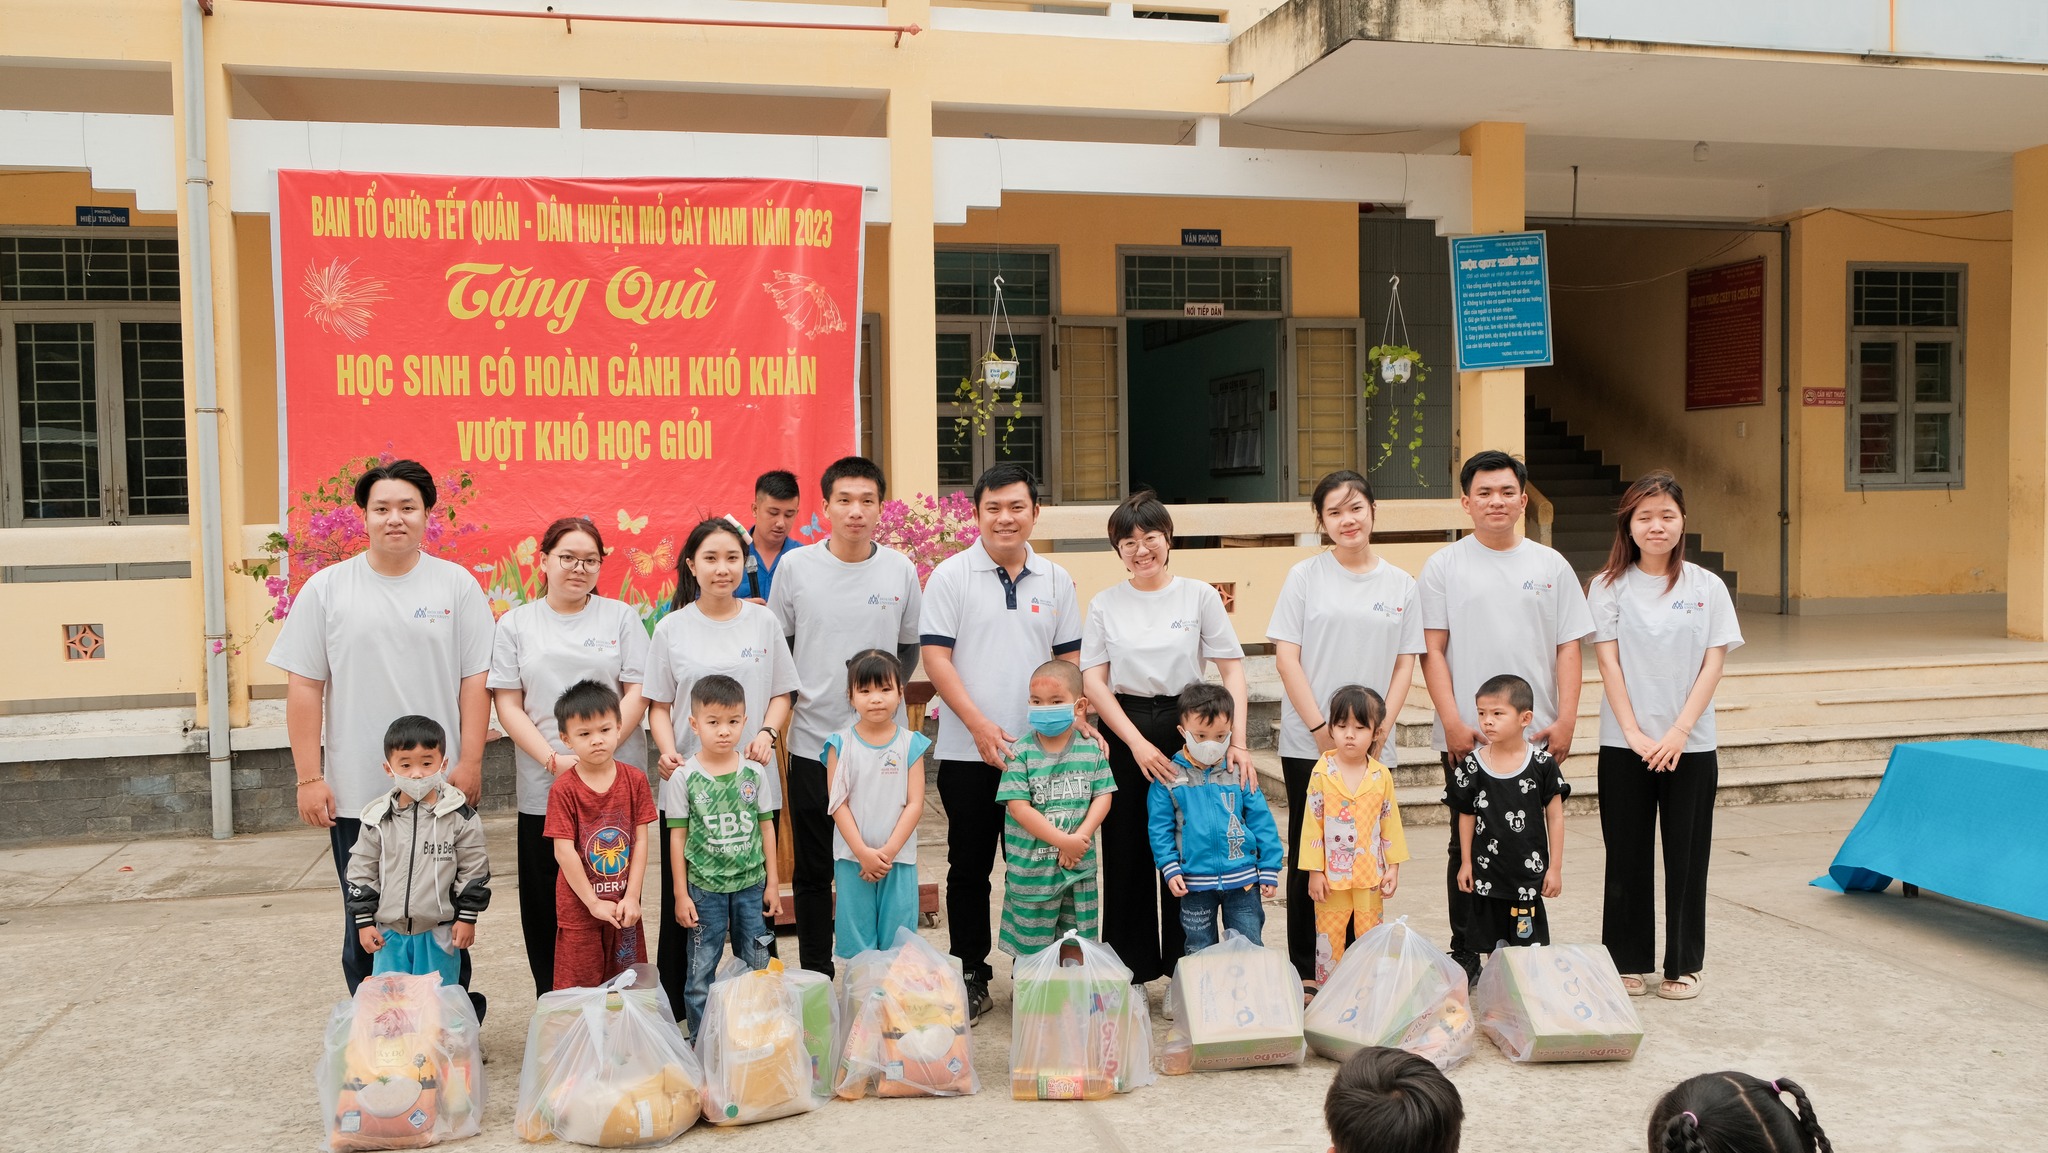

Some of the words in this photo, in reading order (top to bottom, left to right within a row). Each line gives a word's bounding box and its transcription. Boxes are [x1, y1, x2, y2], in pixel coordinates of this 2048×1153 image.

[80, 215, 97, 224] HIỆU
[98, 214, 126, 223] TRƯỞNG
[311, 195, 350, 237] BAN
[355, 181, 377, 238] TỔ
[383, 190, 430, 239] CHỨC
[435, 187, 466, 239] TẾT
[471, 192, 519, 245] QUÂN
[537, 194, 573, 242] DÂN
[578, 196, 634, 253] HUYỆN
[639, 192, 666, 245] MỎ
[671, 198, 703, 245] CÀY
[708, 206, 747, 245] NAM
[752, 199, 790, 246] NĂM
[795, 208, 833, 248] 2023
[1184, 232, 1197, 243] VĂN
[1198, 232, 1218, 243] PHÒNG
[445, 262, 590, 334] Tặng
[605, 265, 717, 325] Quà
[1186, 306, 1195, 315] NƠI
[1197, 304, 1209, 315] TIẾP
[1211, 306, 1222, 315] DÂN
[337, 354, 393, 406] HỌC
[403, 355, 470, 397] SINH
[480, 347, 515, 397] CÓ
[525, 347, 599, 397] HOÀN
[608, 342, 680, 397] CẢNH
[689, 347, 741, 397] KHÓ
[750, 348, 817, 396] KHĂN
[457, 418, 526, 471] VƯỢT
[535, 411, 589, 462] KHÓ
[598, 420, 650, 470] HỌC
[660, 407, 712, 461] GIỎI
[423, 841, 442, 854] Brae
